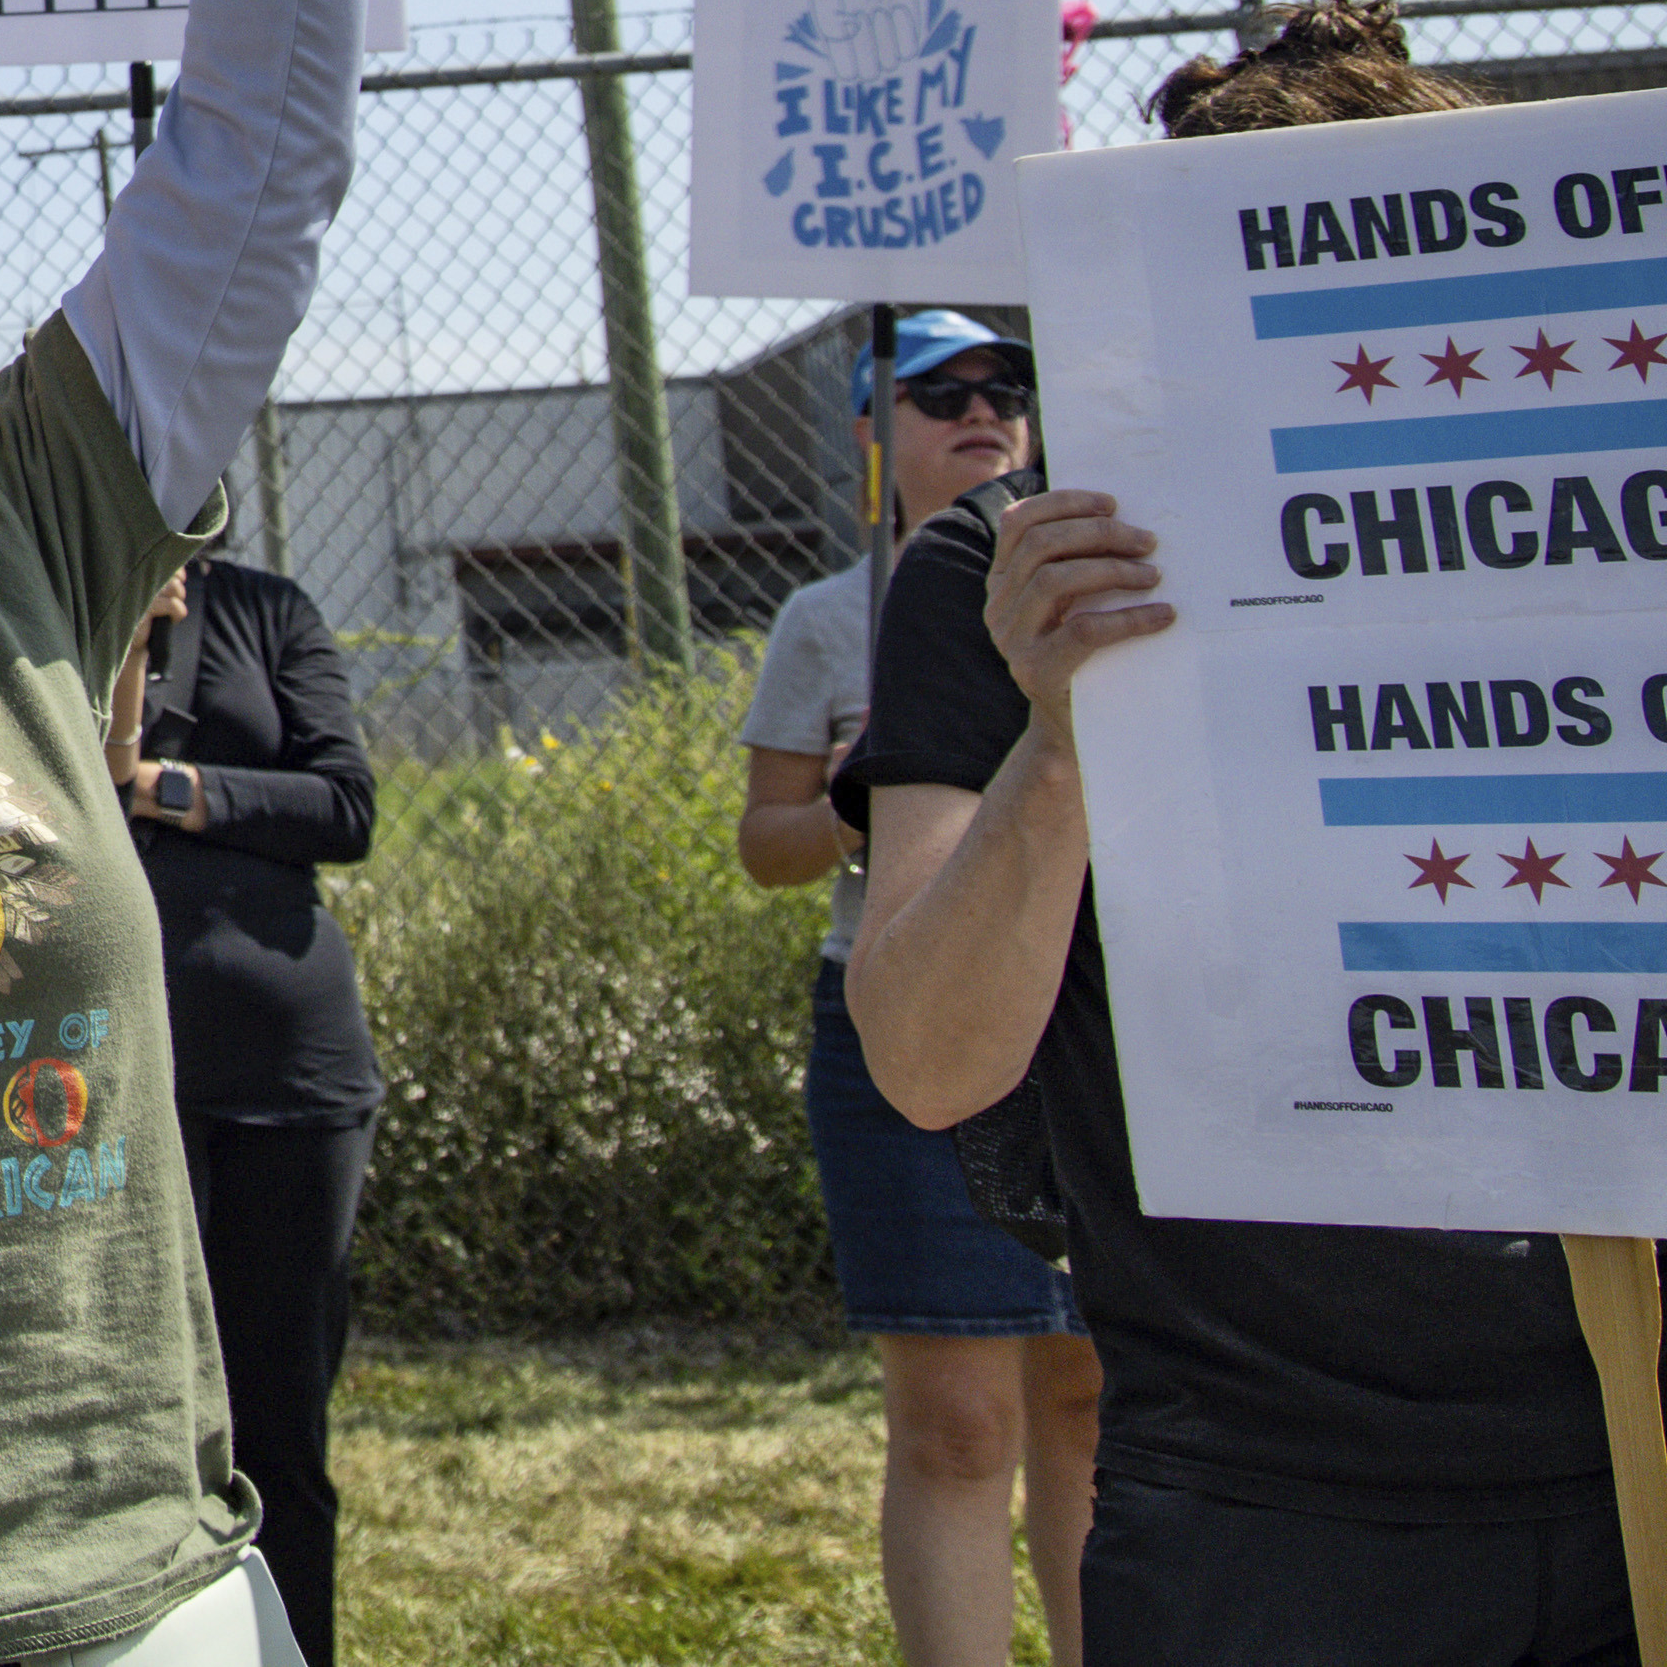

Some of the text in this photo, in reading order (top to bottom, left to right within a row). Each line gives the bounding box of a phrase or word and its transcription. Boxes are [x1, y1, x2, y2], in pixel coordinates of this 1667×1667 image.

[776, 25, 977, 138] I LIKE MY
[813, 123, 956, 198] I.C.E.
[793, 173, 985, 249] CRUSHED
[1238, 163, 1667, 270] HANDS OF
[1230, 594, 1324, 607] #HANDSOFFCHICAGO
[1308, 676, 1613, 751] HANDS
[58, 1009, 110, 1051] OF
[1294, 1101, 1393, 1112] #HANDSOFFCHICAGO
